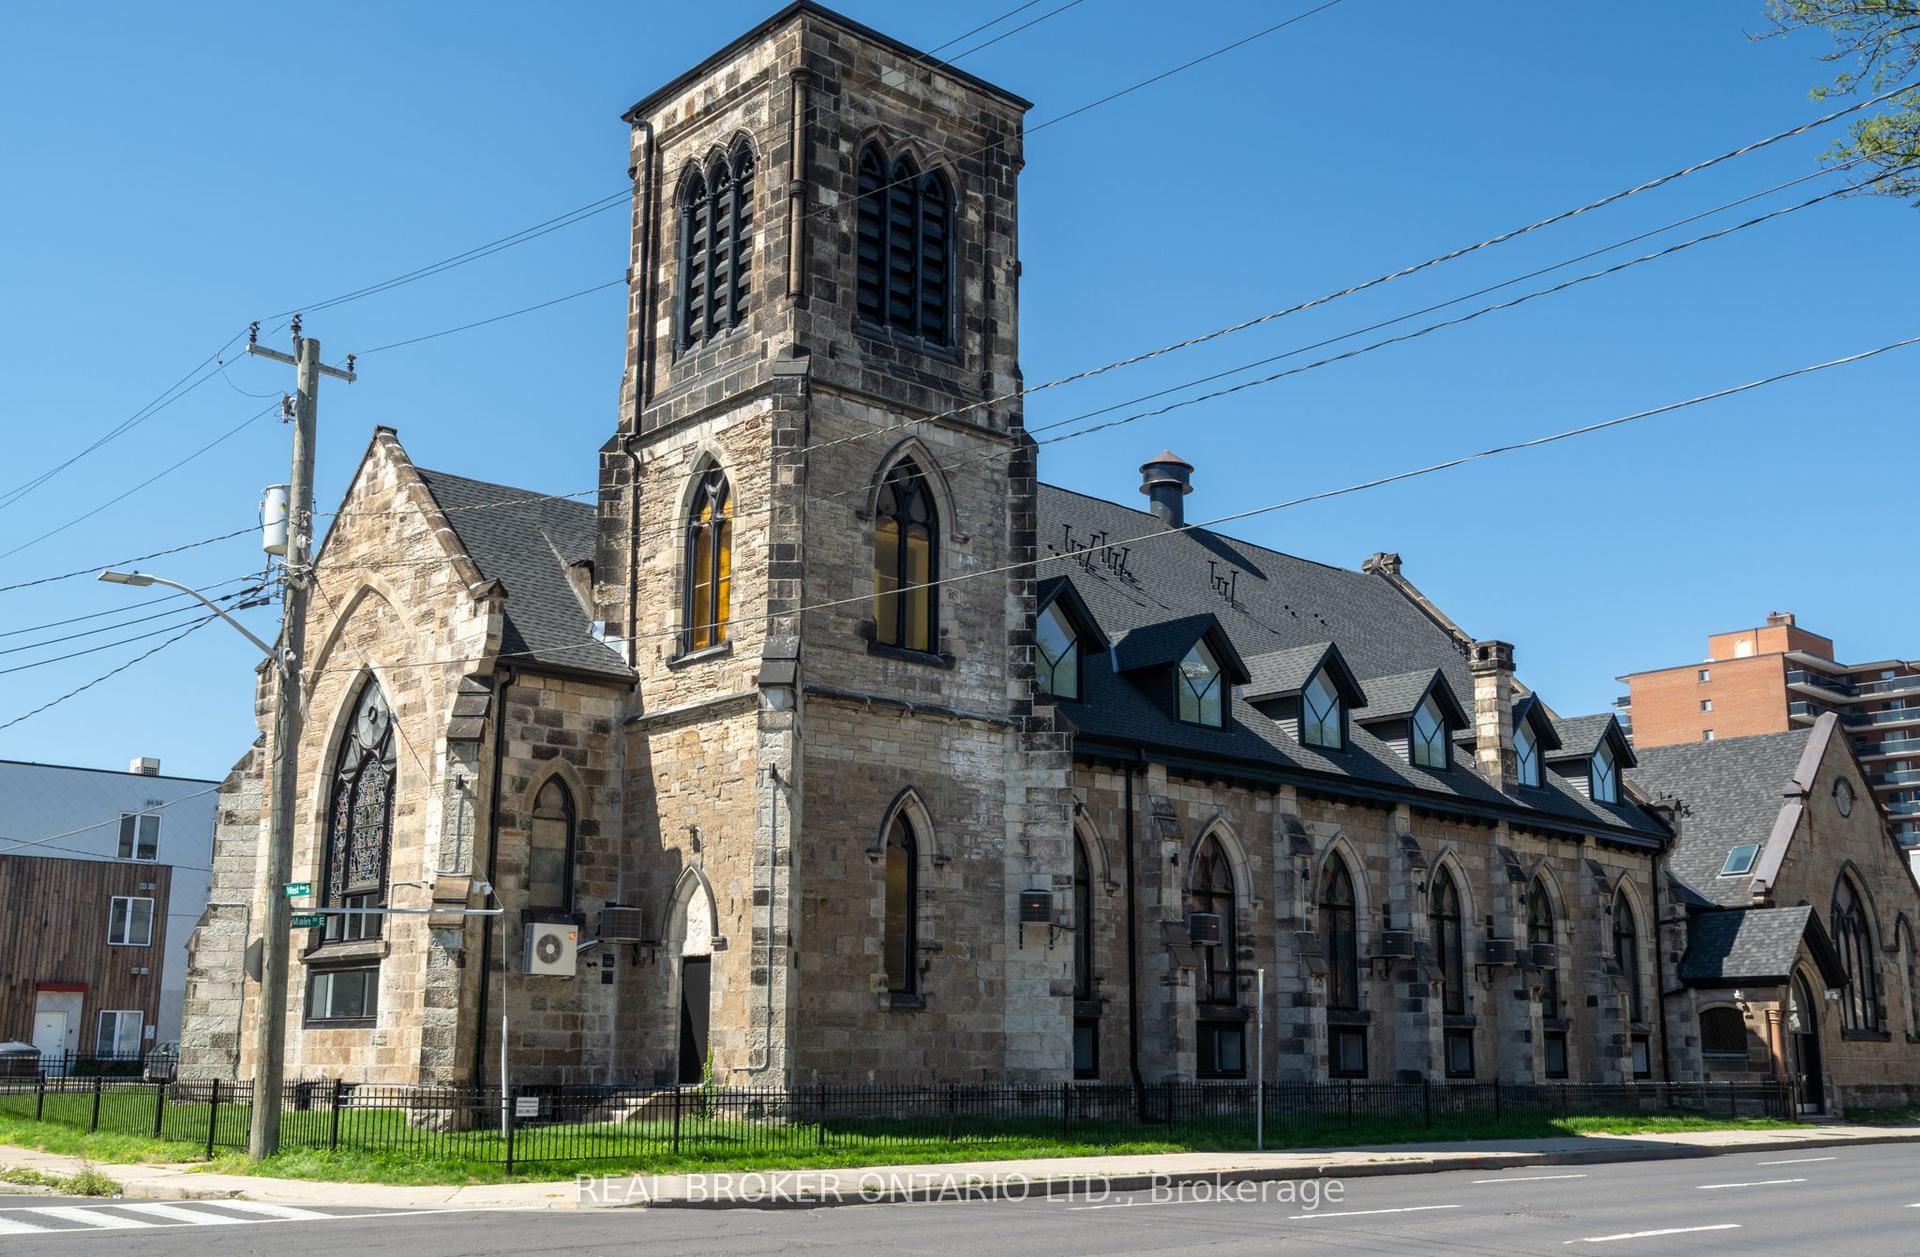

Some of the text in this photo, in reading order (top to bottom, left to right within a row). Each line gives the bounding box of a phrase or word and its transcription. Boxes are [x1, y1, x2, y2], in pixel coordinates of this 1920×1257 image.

[286, 886, 300, 895] West
[305, 885, 310, 894] S
[291, 917, 311, 926] Main
[319, 917, 325, 926] E
